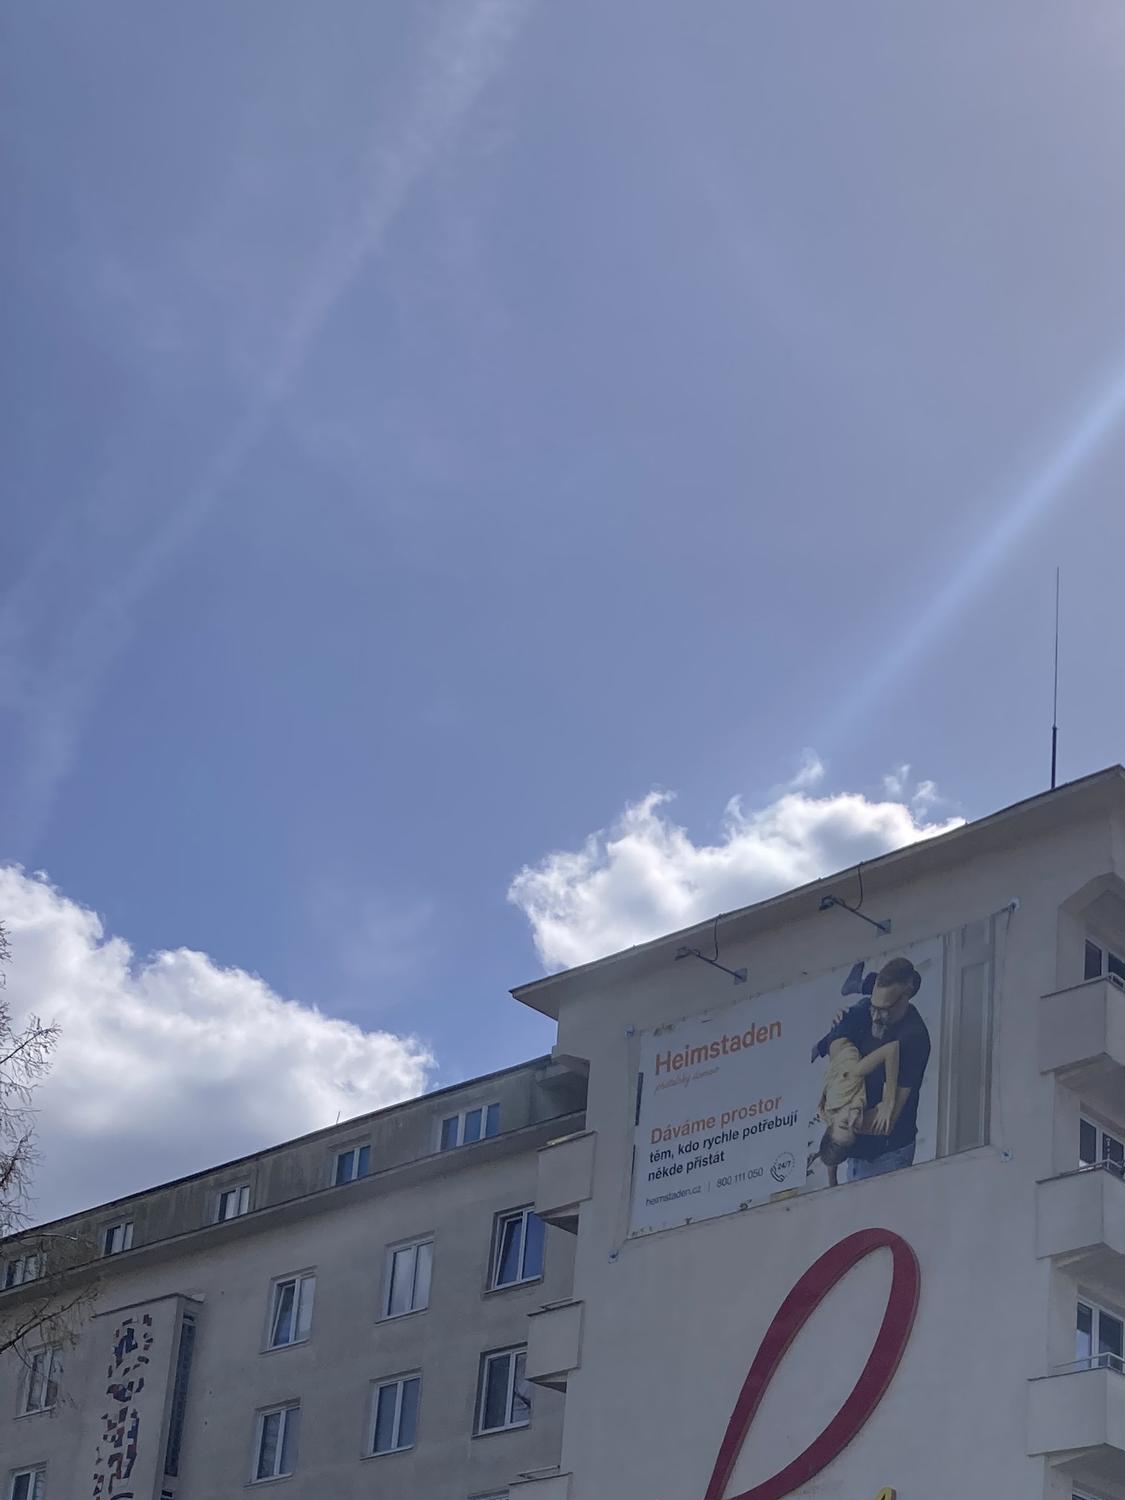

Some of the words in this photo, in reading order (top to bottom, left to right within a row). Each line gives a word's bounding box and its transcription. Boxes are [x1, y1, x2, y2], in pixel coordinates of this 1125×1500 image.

[655, 1020, 783, 1076] Heimstaden
[649, 1149, 675, 1164] těm,
[678, 1140, 700, 1155] kdo
[703, 1128, 740, 1151] rychle
[742, 1110, 799, 1141] potřebují
[650, 1115, 717, 1146] Dáváme
[720, 1096, 784, 1130] prostor
[648, 1162, 684, 1182] někde
[686, 1150, 726, 1174] přistát
[645, 1185, 702, 1208] heimstaden.cz
